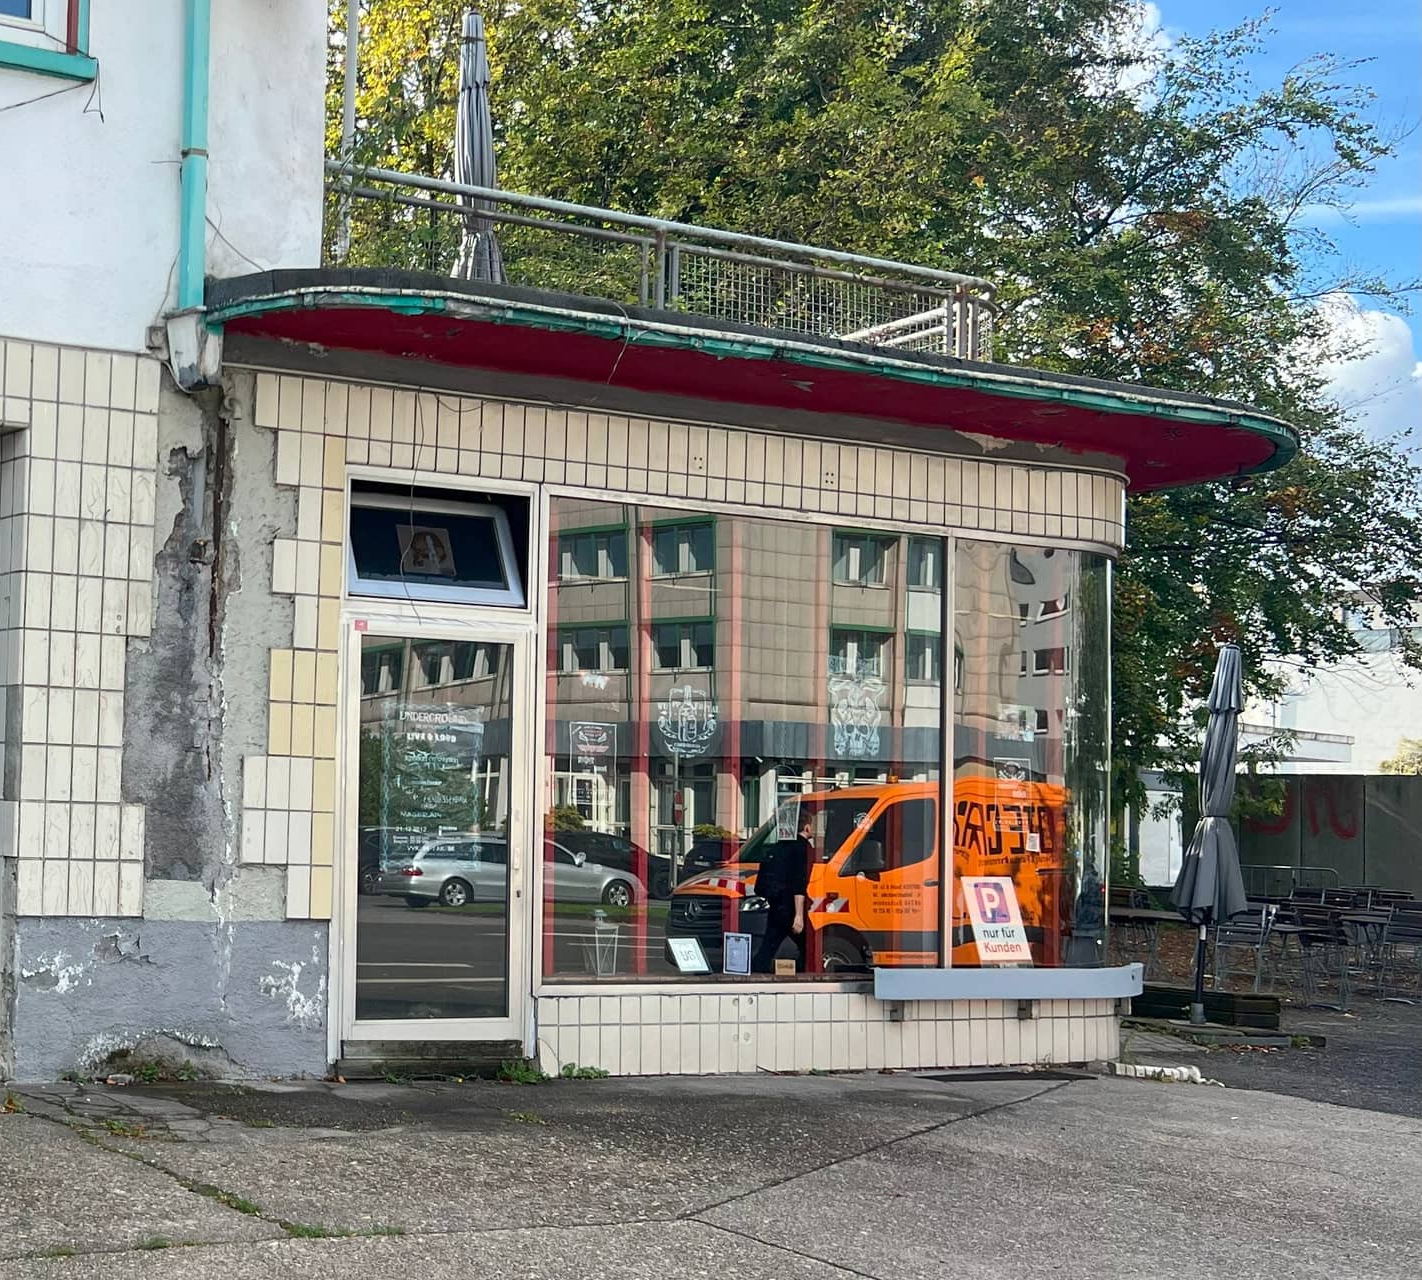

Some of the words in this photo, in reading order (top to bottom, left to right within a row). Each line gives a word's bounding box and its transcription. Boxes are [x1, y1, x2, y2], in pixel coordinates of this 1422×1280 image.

[980, 886, 1000, 918] P
[982, 928, 1000, 939] nur
[1001, 926, 1015, 939] für
[983, 941, 1022, 954] Kunden
